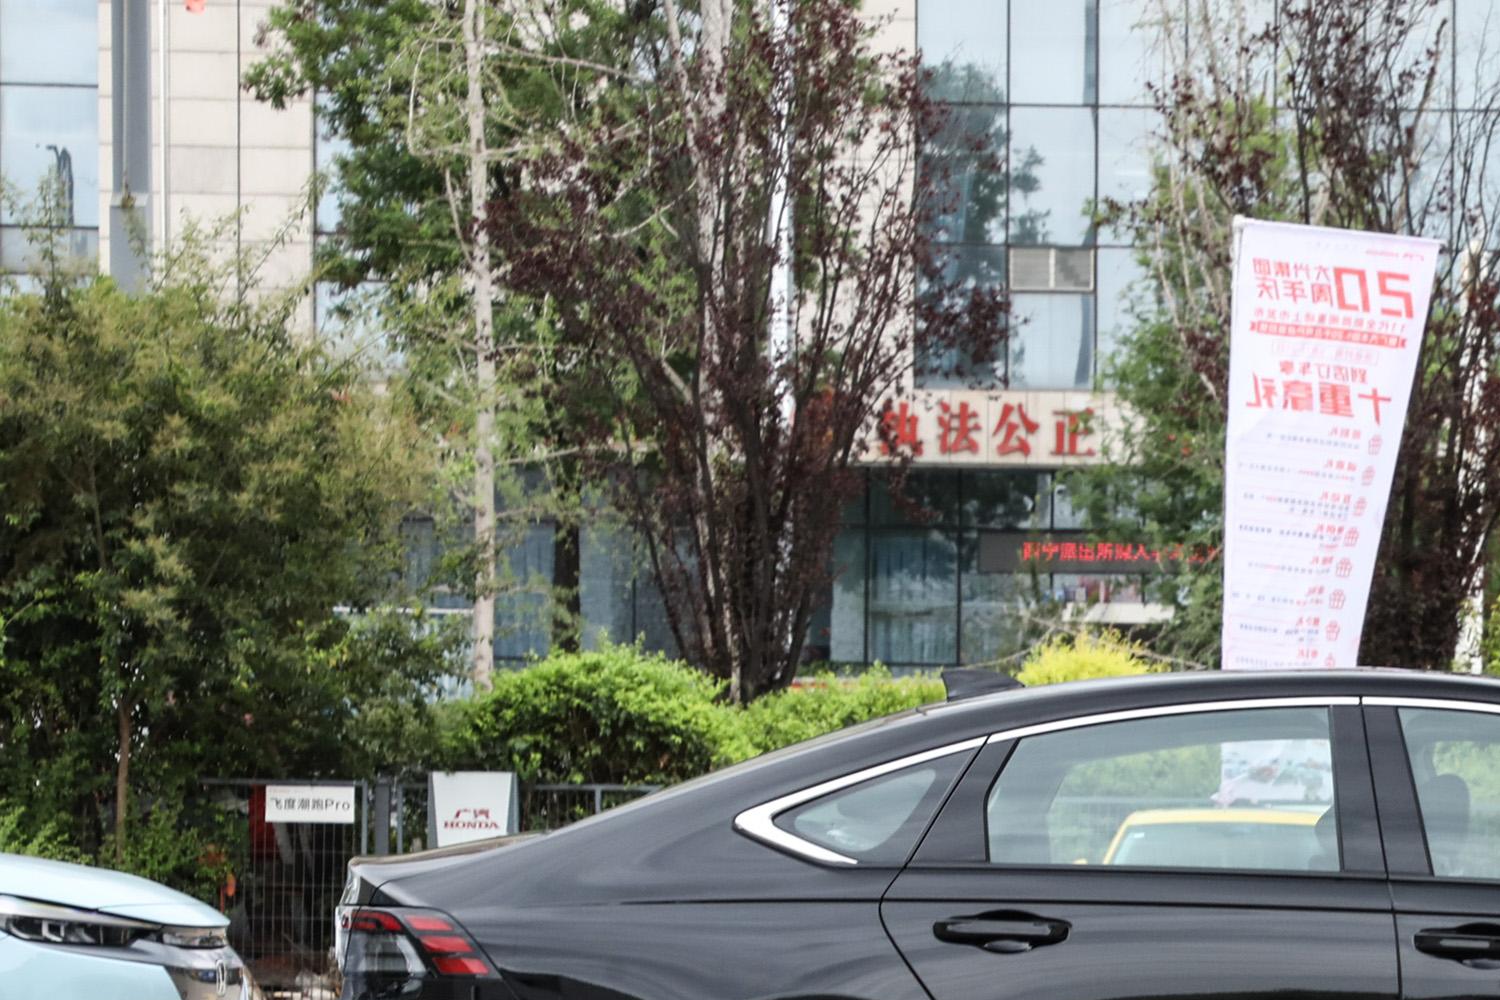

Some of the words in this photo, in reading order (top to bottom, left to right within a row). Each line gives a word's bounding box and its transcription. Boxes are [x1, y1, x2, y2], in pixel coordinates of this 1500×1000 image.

[880, 401, 1096, 457] 执法公正
[270, 797, 351, 811] 飞度潮跑Pro
[454, 807, 491, 819] 广汽
[443, 820, 500, 830] HONDA
